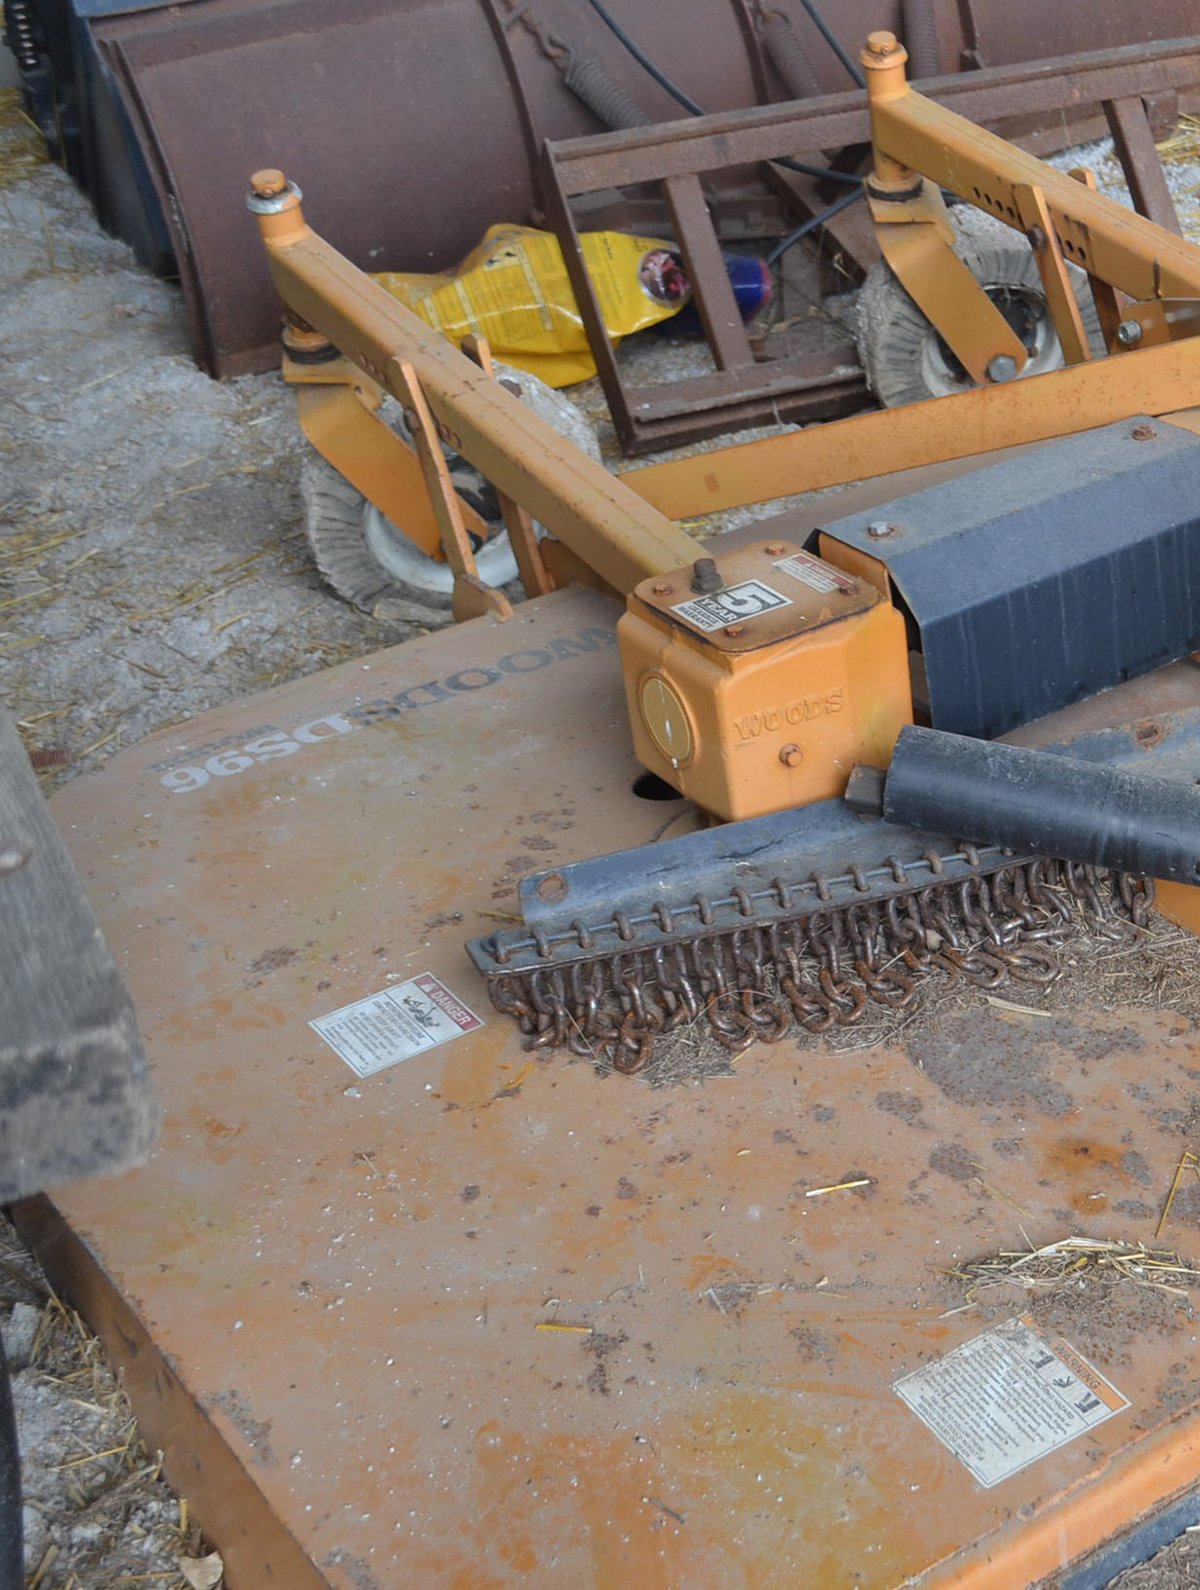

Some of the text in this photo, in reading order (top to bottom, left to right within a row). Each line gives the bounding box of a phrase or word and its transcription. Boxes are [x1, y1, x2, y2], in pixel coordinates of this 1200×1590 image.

[700, 598, 738, 621] YEAR
[717, 583, 781, 614] 5
[345, 626, 618, 725] WOODS
[733, 687, 844, 741] WOODS
[160, 713, 356, 794] DS96
[430, 989, 472, 1026] DANGER
[1054, 1344, 1102, 1390] WARNING
